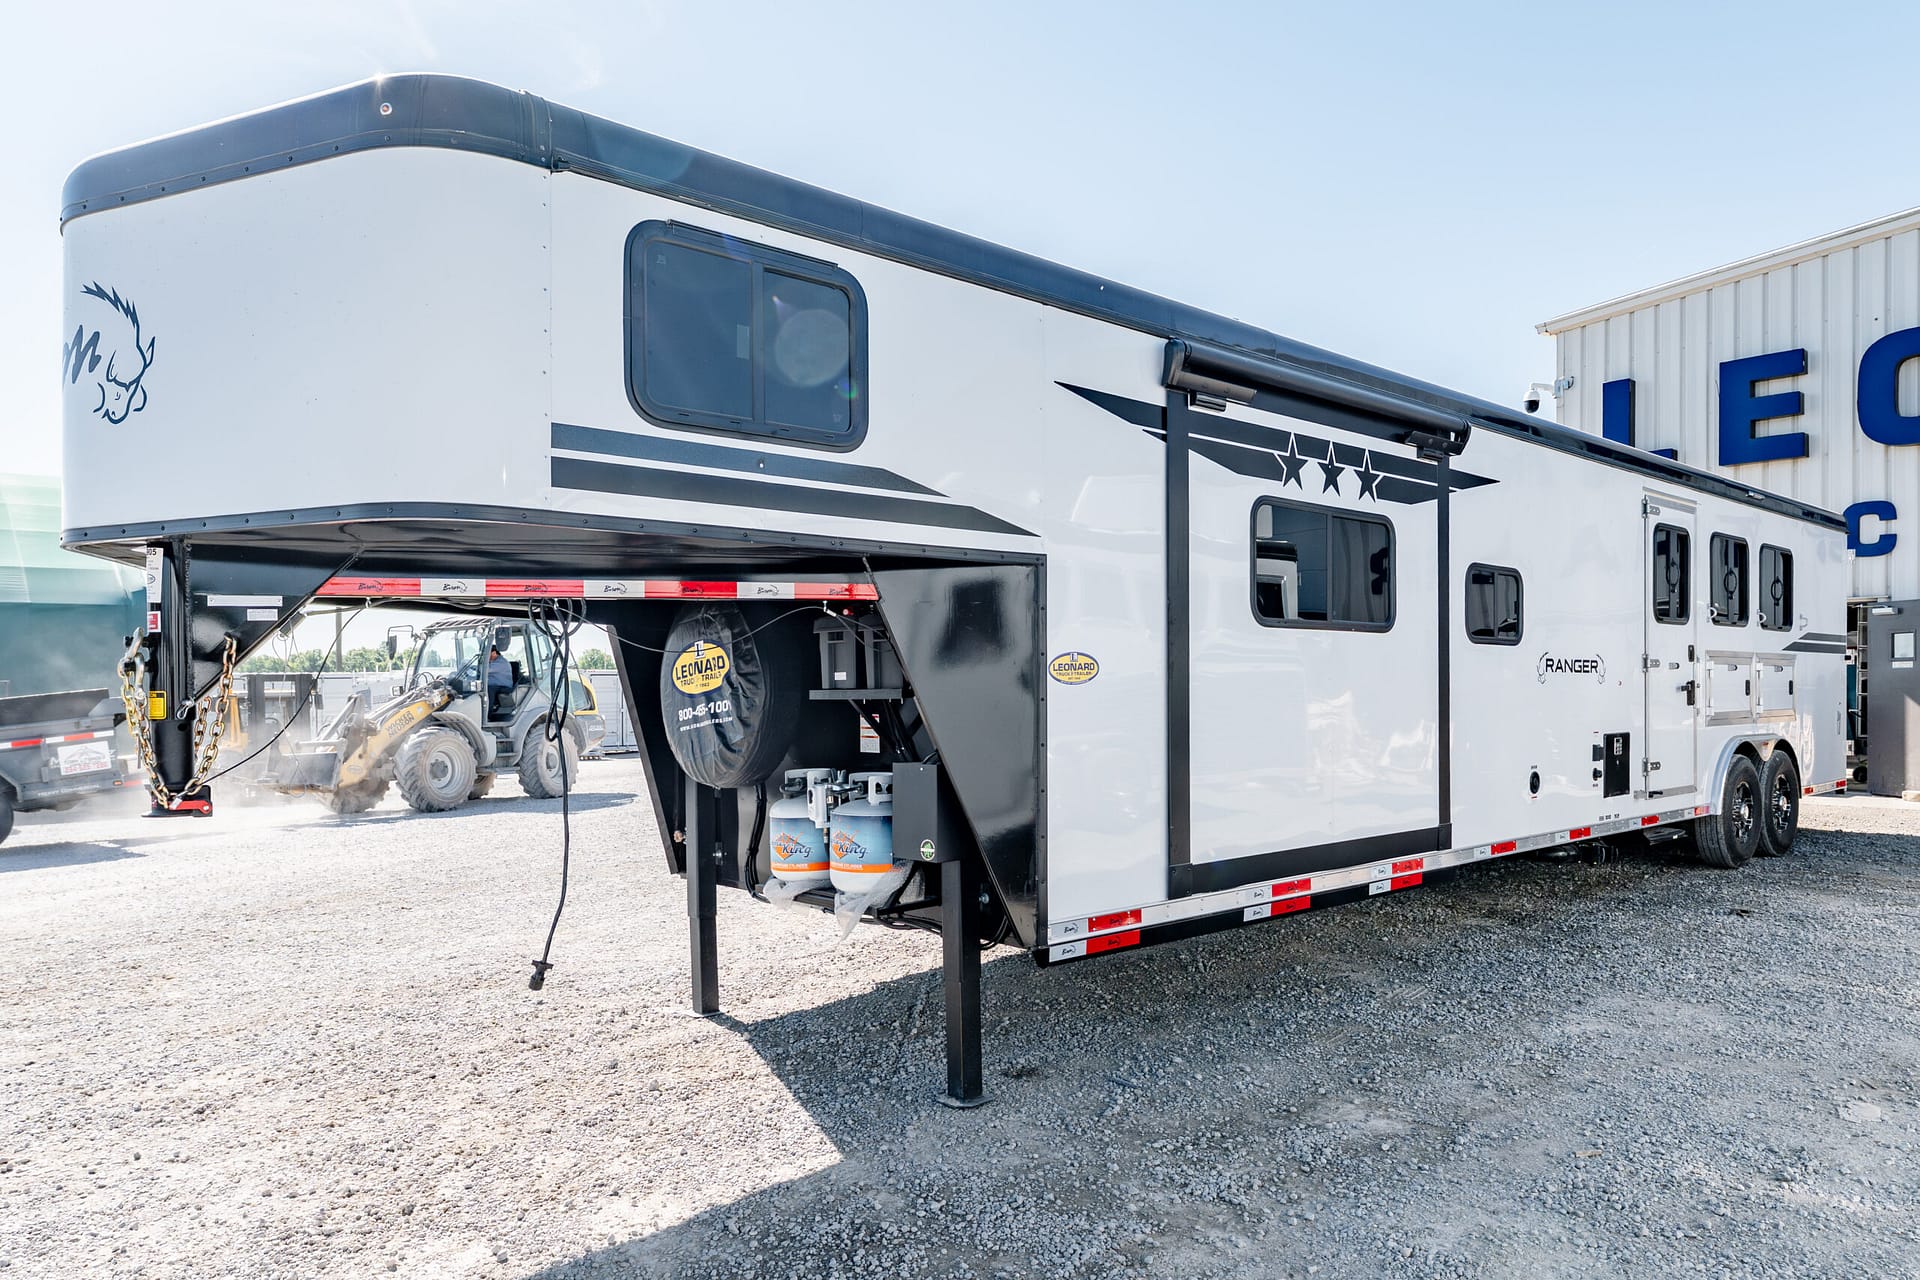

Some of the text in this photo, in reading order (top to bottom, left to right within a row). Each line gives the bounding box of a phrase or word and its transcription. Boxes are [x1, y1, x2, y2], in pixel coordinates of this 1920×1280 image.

[1052, 662, 1095, 671] LEONARD
[1545, 658, 1599, 674] RANGER
[782, 843, 811, 858] King
[838, 842, 867, 858] King
